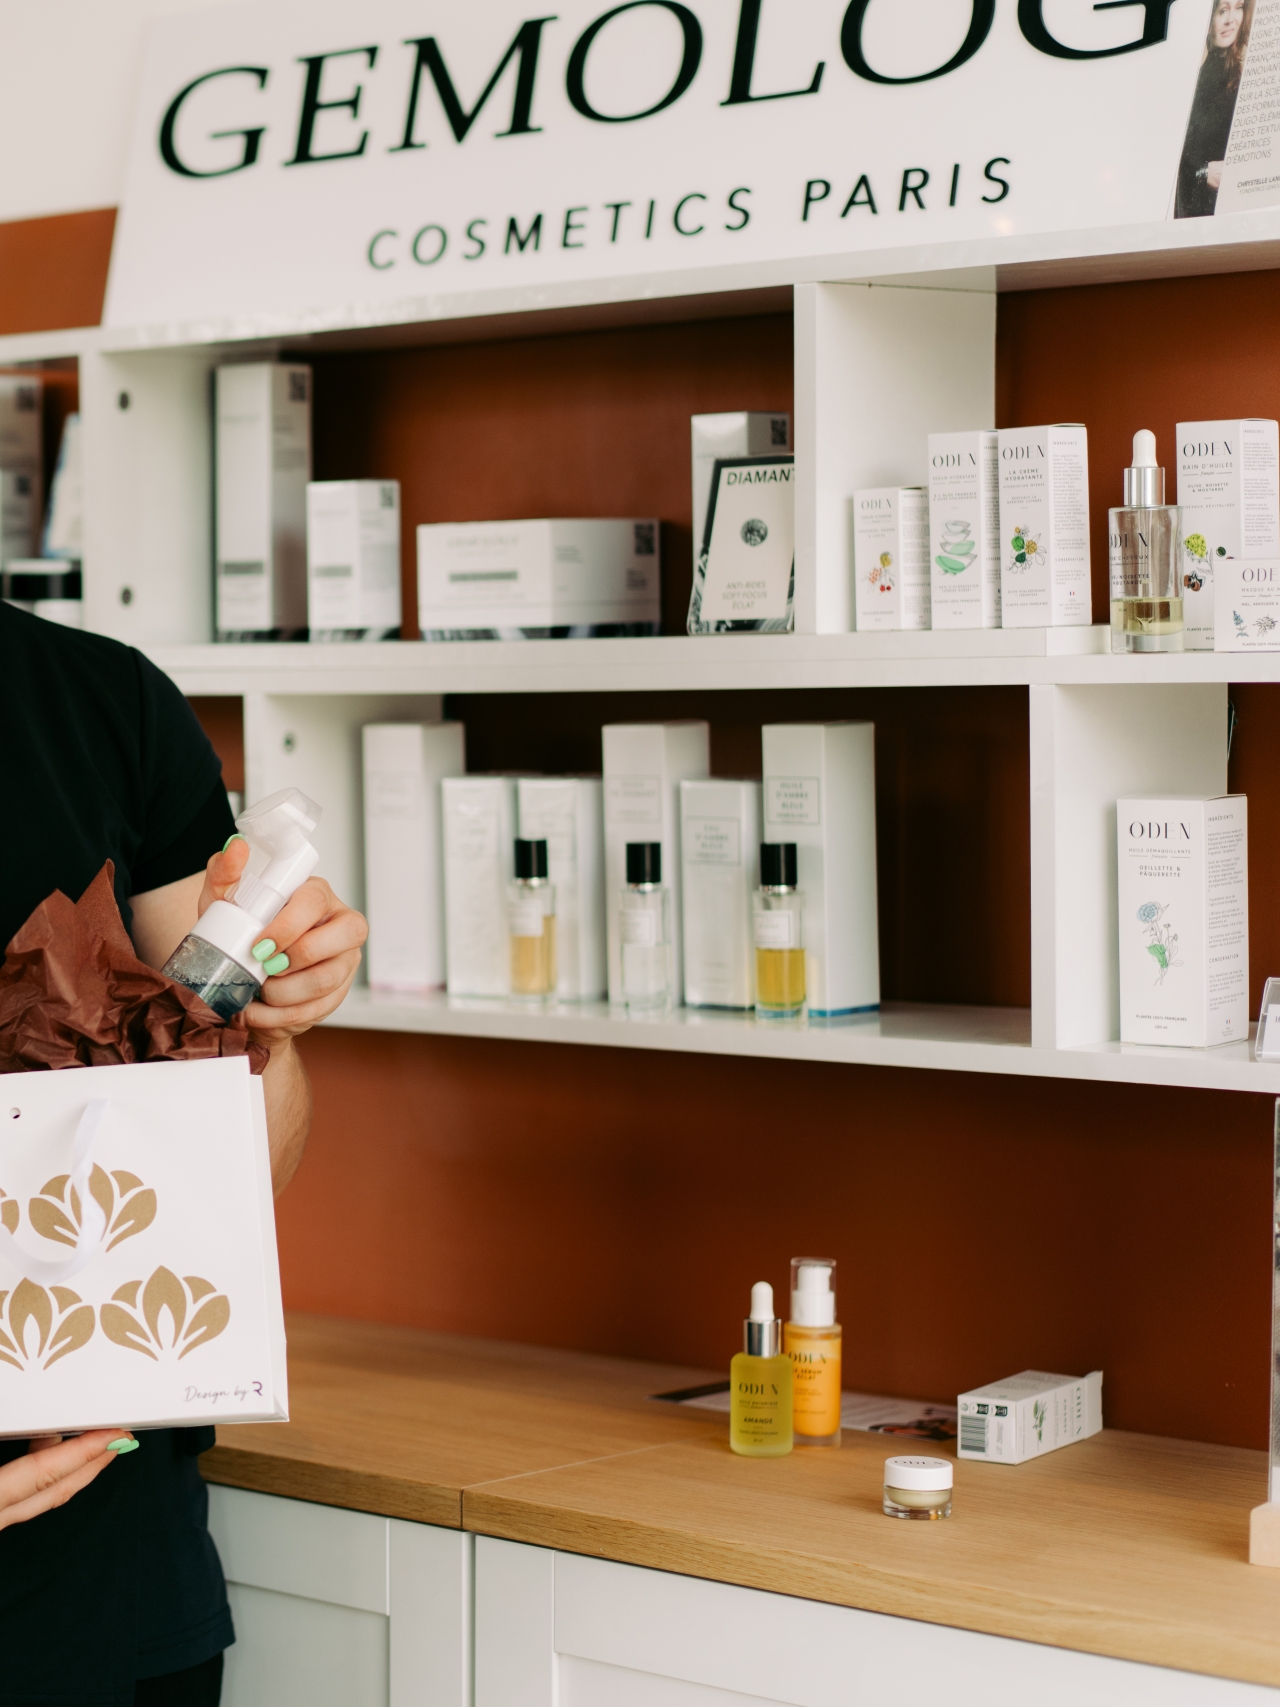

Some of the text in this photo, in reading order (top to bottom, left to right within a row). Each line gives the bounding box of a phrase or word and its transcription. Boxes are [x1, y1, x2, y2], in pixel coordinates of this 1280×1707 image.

[1228, 137, 1272, 152] CRÉATRICES
[1225, 149, 1273, 165] D'ÉMOTIONS
[366, 156, 1012, 270] COSMETICS PARIS
[1002, 444, 1045, 460] ODEN
[1183, 441, 1233, 458] ODEN
[932, 452, 977, 468] ODEN
[727, 467, 794, 486] DIAMAN
[861, 498, 892, 510] ODEN
[1242, 568, 1279, 582] ODE
[1129, 821, 1190, 839] ODEN
[183, 1385, 230, 1404] Design
[234, 1385, 249, 1401] by
